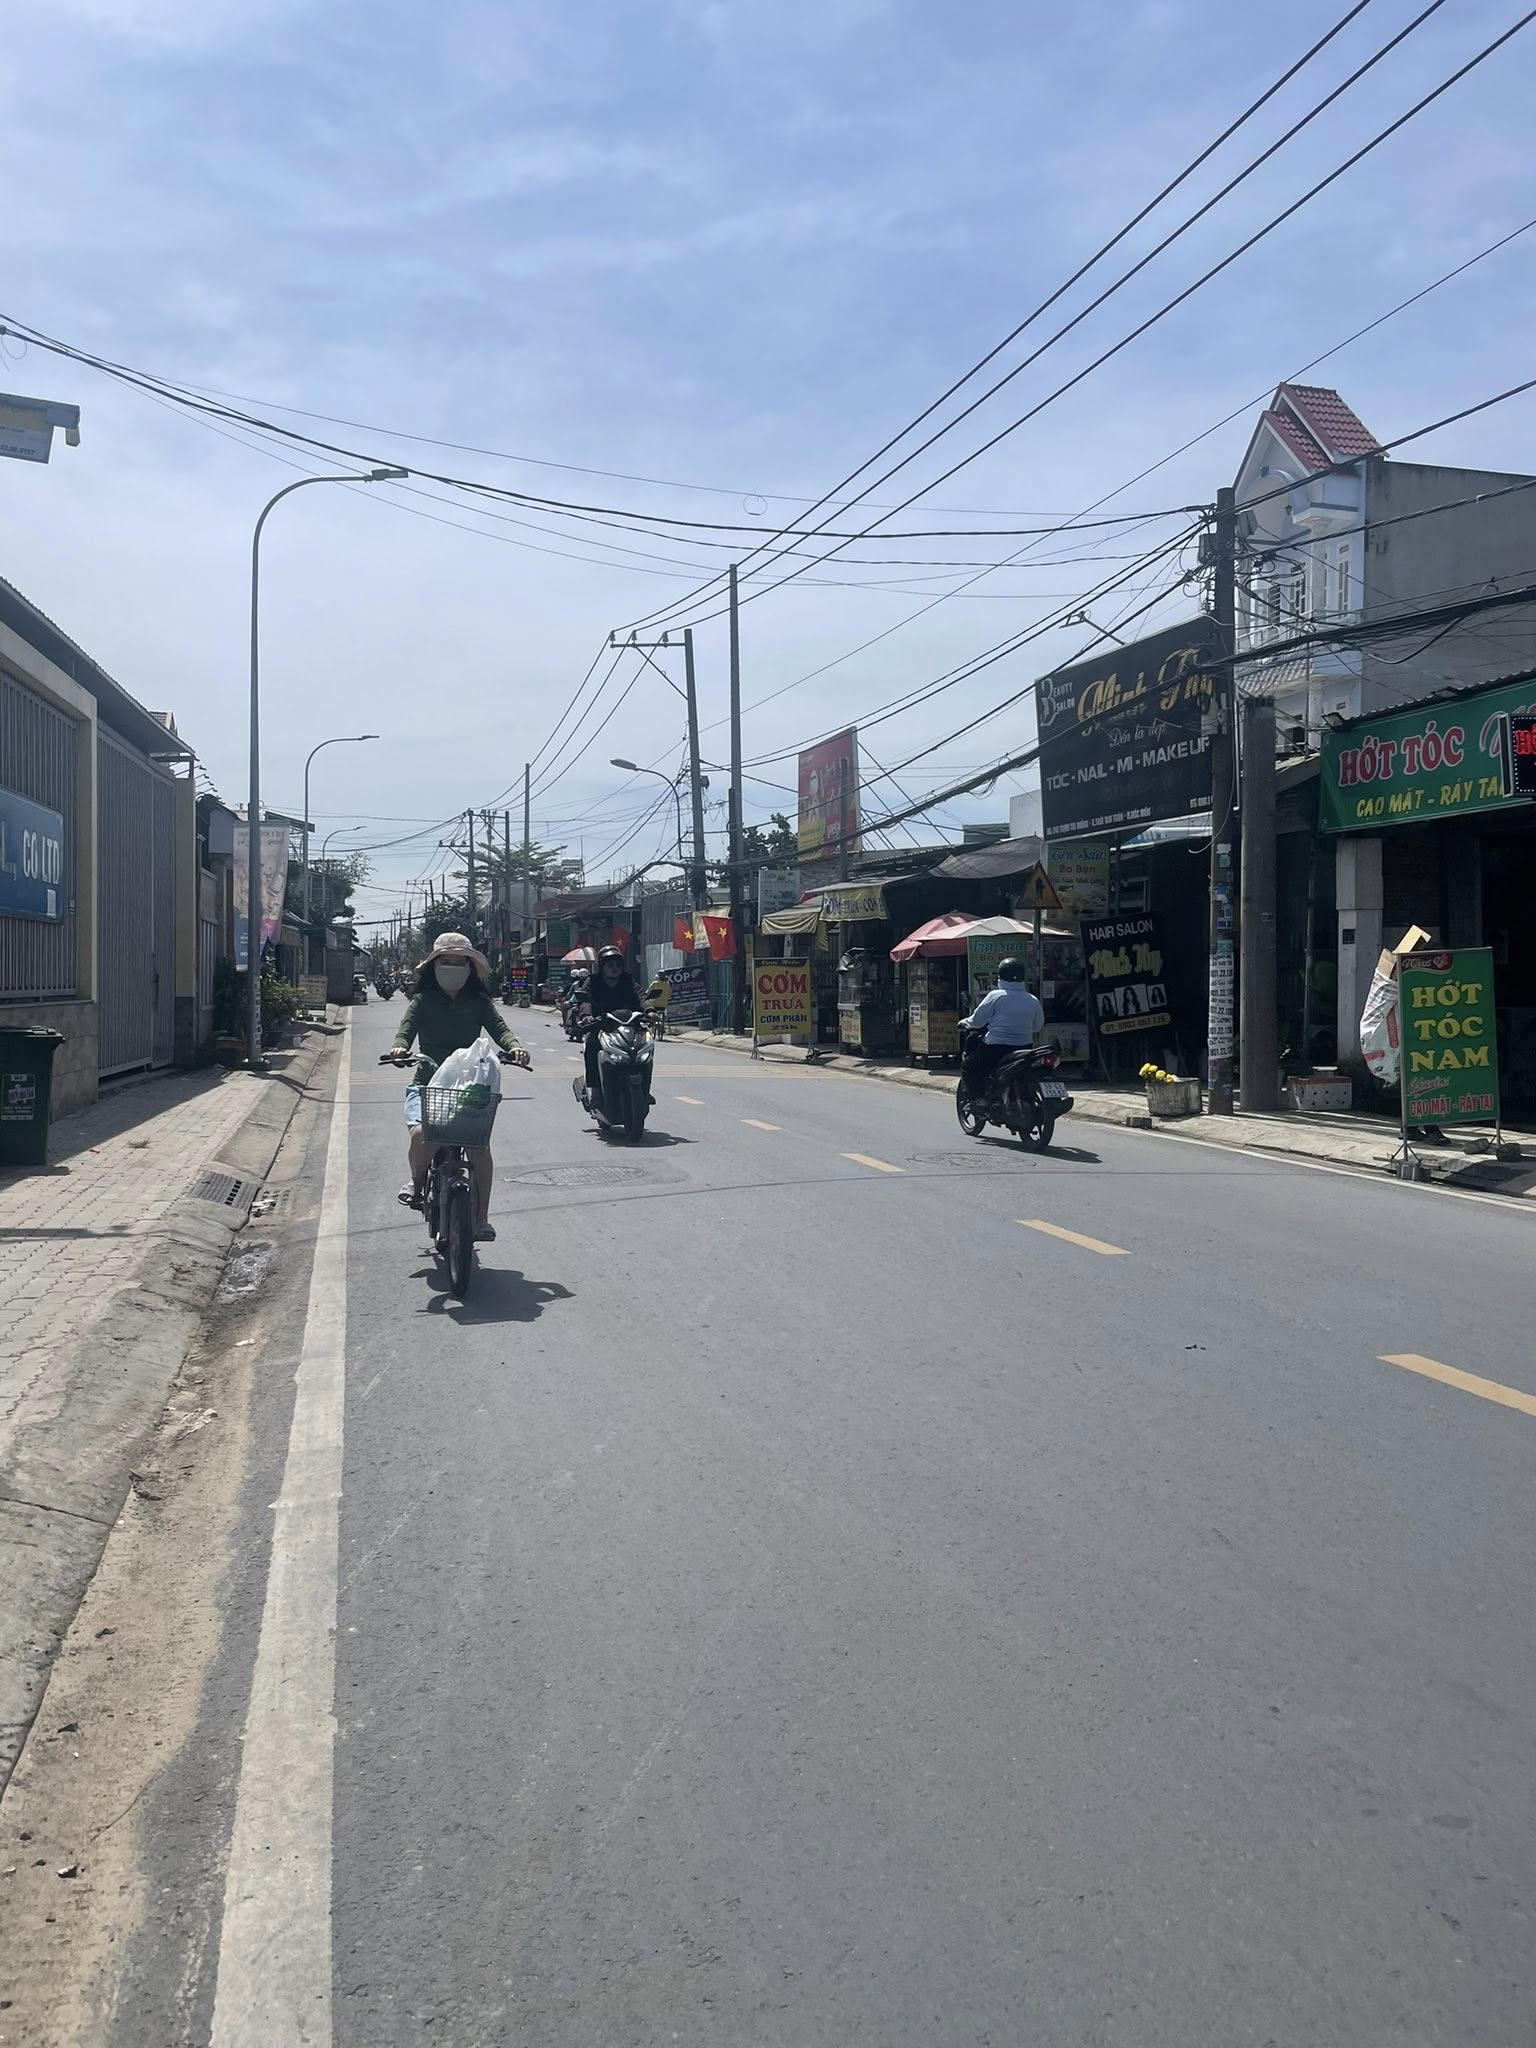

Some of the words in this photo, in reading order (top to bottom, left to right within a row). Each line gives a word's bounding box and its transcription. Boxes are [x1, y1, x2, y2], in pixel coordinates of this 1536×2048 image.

[1055, 697, 1076, 711] SALON
[1338, 735, 1397, 787] HỚT
[1401, 720, 1465, 775] TÓC
[1046, 769, 1070, 791] TÓC
[1077, 765, 1108, 784] NAIL
[1356, 795, 1385, 821] CẠO
[1388, 787, 1425, 815] MẶT
[1440, 777, 1473, 806] RÁY
[42, 835, 60, 885] LTD
[1089, 924, 1115, 941] HAIR
[1116, 918, 1153, 937] SALON
[757, 970, 808, 995] CƠM
[1411, 978, 1483, 1009] HỚT
[761, 997, 805, 1011] TRƯA
[1413, 1012, 1484, 1042] TÓC
[1410, 1046, 1490, 1073] NAM
[1409, 1098, 1429, 1120] CẠO
[1430, 1094, 1452, 1118] MẶT
[1459, 1092, 1477, 1114] RÁY
[1478, 1093, 1494, 1112] TAI
